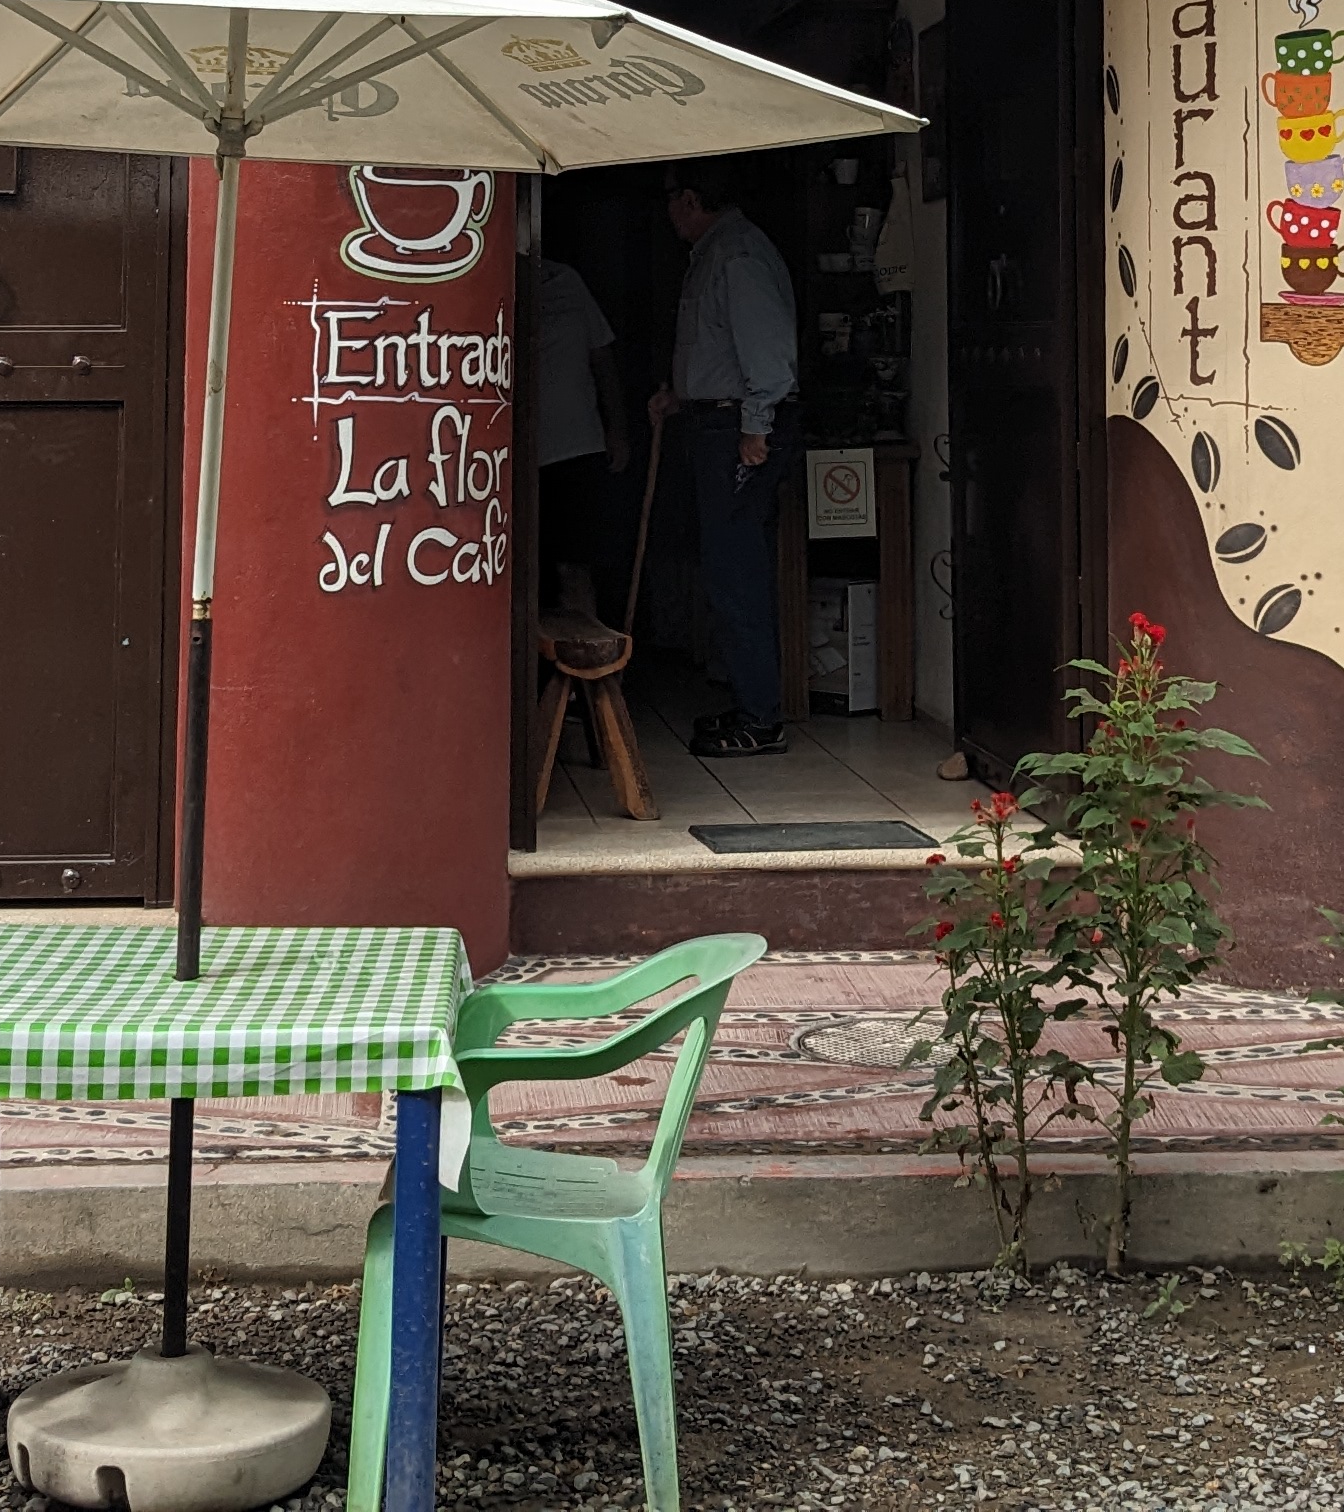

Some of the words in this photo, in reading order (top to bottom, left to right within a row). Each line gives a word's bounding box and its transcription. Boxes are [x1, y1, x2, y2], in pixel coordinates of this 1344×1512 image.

[321, 306, 511, 388] Entrada
[328, 418, 411, 506] La
[428, 406, 508, 506] flor
[319, 524, 391, 592] del
[407, 499, 506, 586] Café
